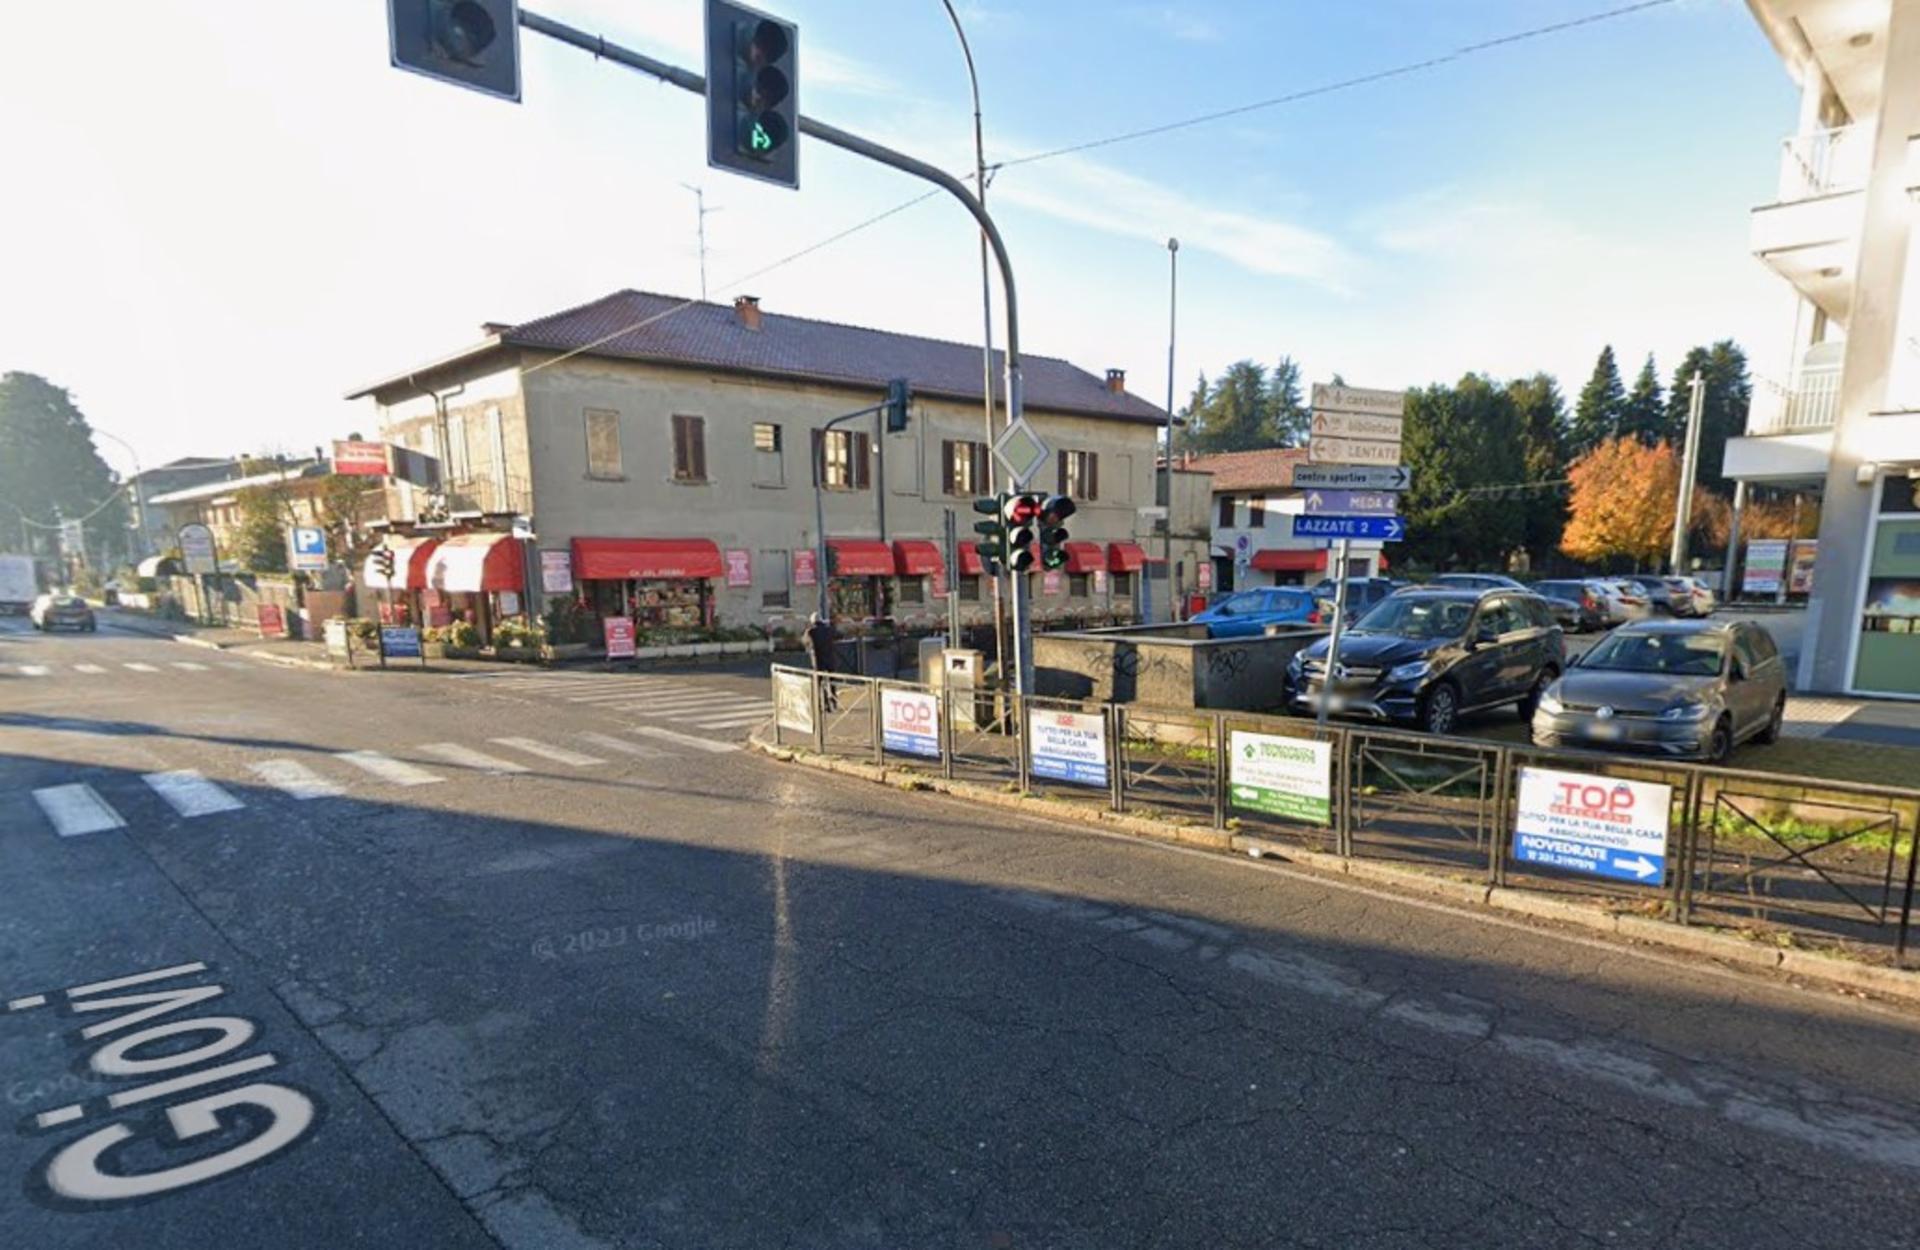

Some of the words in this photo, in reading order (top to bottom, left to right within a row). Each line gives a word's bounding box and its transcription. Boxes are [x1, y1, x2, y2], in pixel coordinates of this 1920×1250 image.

[1296, 471, 1326, 482] centro
[1330, 472, 1367, 486] sportivo
[1349, 496, 1382, 509] MEDA
[1386, 498, 1394, 509] 4
[1296, 520, 1355, 534] LAZZATE
[1360, 522, 1369, 533] 2
[297, 529, 319, 552] P
[890, 699, 931, 725] TOP
[1558, 782, 1635, 811] TOP
[1549, 816, 1565, 826] PER
[1568, 819, 1579, 828] LA
[1582, 821, 1602, 831] TUA
[1605, 825, 1633, 836] BELLA
[1635, 828, 1663, 840] CASA
[1521, 836, 1608, 861] NOVEDRATE
